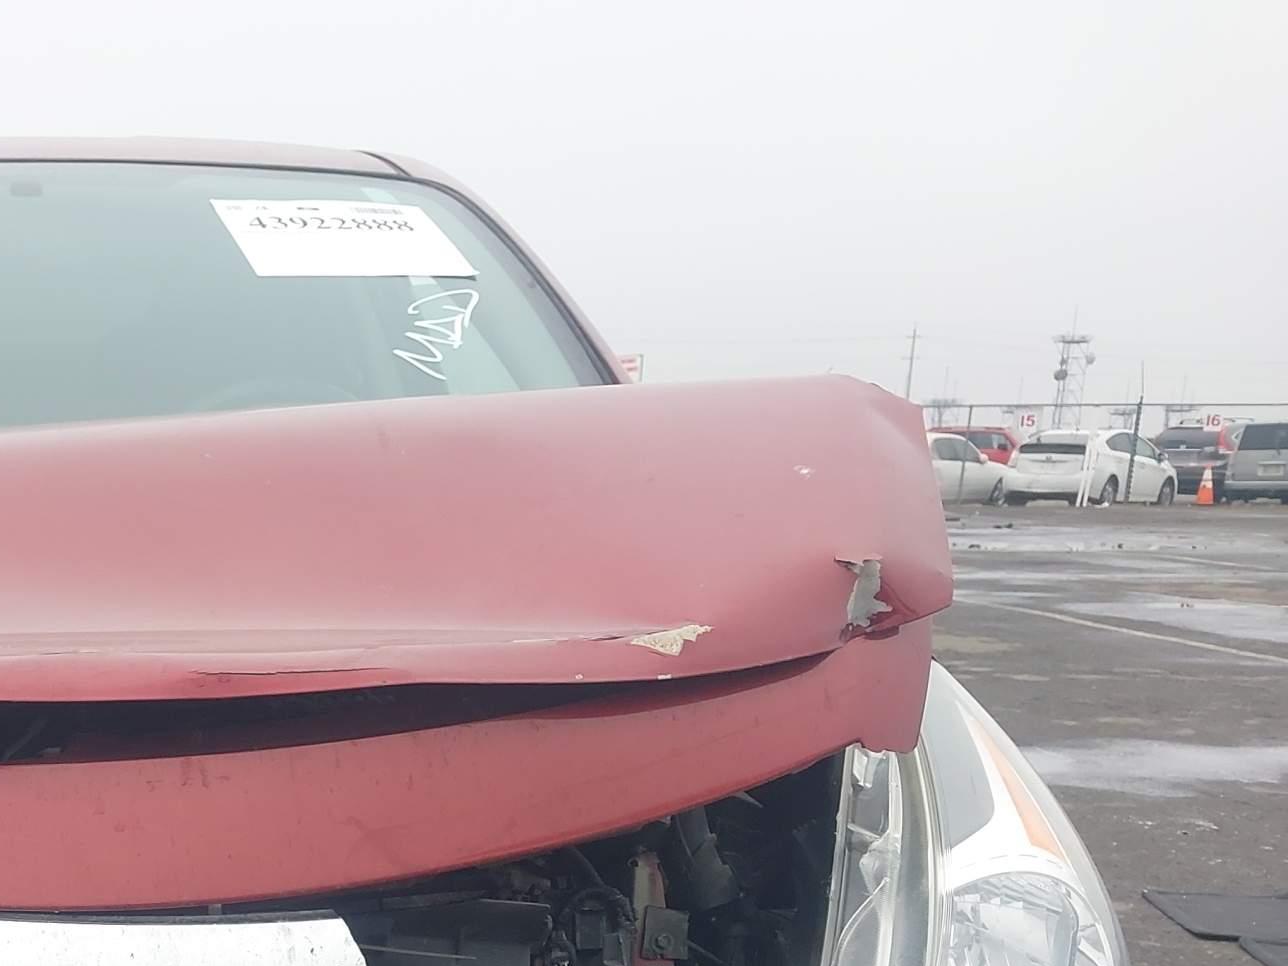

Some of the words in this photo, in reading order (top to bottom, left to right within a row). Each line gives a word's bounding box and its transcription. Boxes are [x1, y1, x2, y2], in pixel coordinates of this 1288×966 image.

[249, 215, 414, 232] 43922888
[1020, 414, 1036, 428] 15
[1206, 414, 1221, 426] 16
